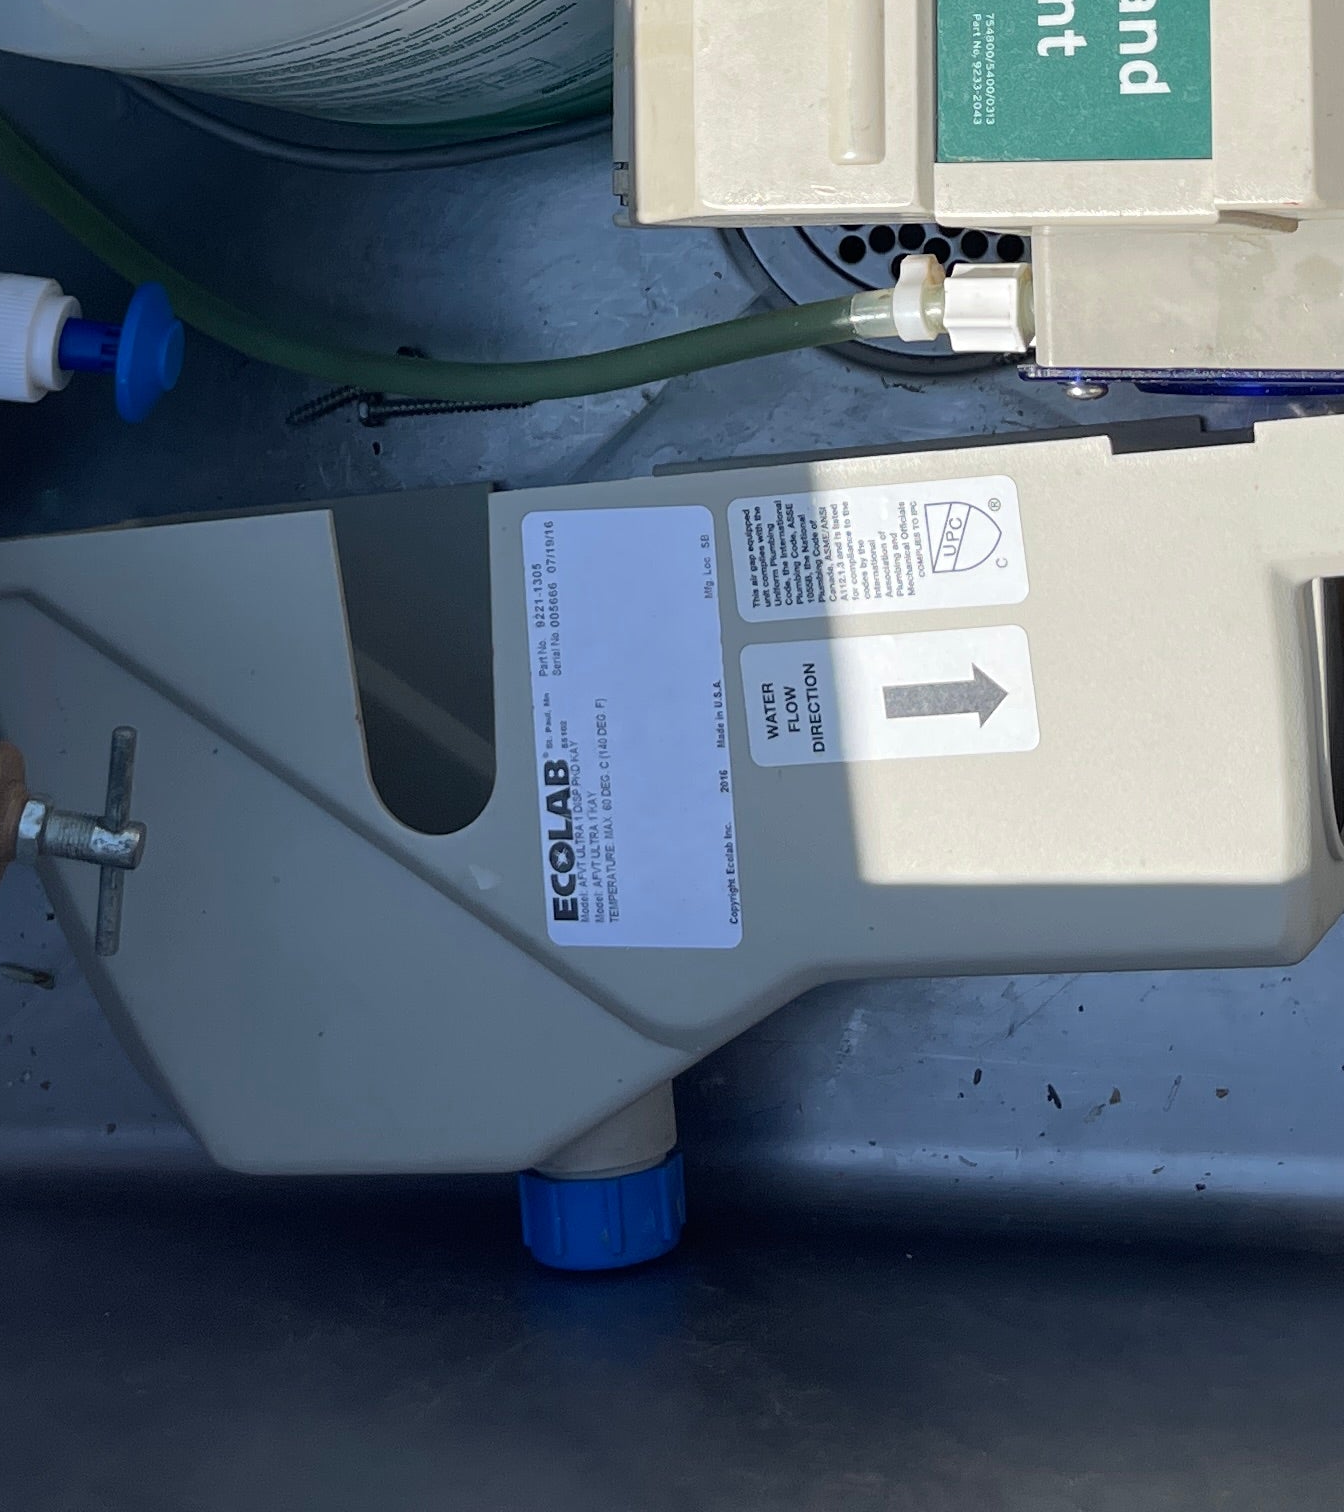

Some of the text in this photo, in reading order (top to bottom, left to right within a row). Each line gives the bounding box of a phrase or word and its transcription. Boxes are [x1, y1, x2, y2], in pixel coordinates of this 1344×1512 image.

[972, 13, 982, 37] Part
[972, 61, 982, 125] 9233-2043
[985, 13, 996, 125] 754800/5400/0313
[544, 520, 557, 573] 07/19/16
[798, 514, 810, 552] National
[819, 506, 832, 561] ASME/ANSI
[898, 501, 916, 595] Mechanical Officials
[913, 517, 920, 529] TO
[940, 517, 966, 556] UPC
[743, 508, 761, 607] This air gap equipped
[754, 506, 772, 606] unit complies with the
[766, 523, 783, 606] Uniform Plumbing
[774, 499, 794, 605] Code, the International
[786, 503, 806, 604] Plumbing Code, ASSE
[803, 555, 811, 569] the
[810, 519, 828, 602] Plumbing Code of
[830, 503, 849, 600] A112.1.3 and is listed
[842, 501, 860, 600] for compliance to the
[860, 557, 868, 568] by
[869, 539, 882, 598] International
[879, 530, 893, 597] Association of
[891, 532, 906, 596] Plumbing and
[533, 563, 546, 627] 9221-1305
[548, 582, 560, 627] 005666
[861, 571, 871, 599] codes
[538, 656, 549, 676] Part
[552, 648, 563, 675] Serial
[715, 711, 724, 719] in
[762, 682, 779, 739] WATER
[784, 685, 801, 732] FLOW
[804, 662, 825, 752] DIRECTION
[715, 722, 726, 747] Made
[572, 789, 584, 812] DISP
[588, 790, 598, 812] KAY
[603, 798, 613, 810] 60
[720, 769, 729, 792] 2016
[544, 759, 579, 920] ECOLAB
[575, 824, 587, 858] ULTRA
[590, 824, 601, 858] ULTRA
[577, 860, 588, 887] AFVT
[592, 860, 603, 887] AFVT
[723, 822, 741, 923] Copyright Ecolab Inc.
